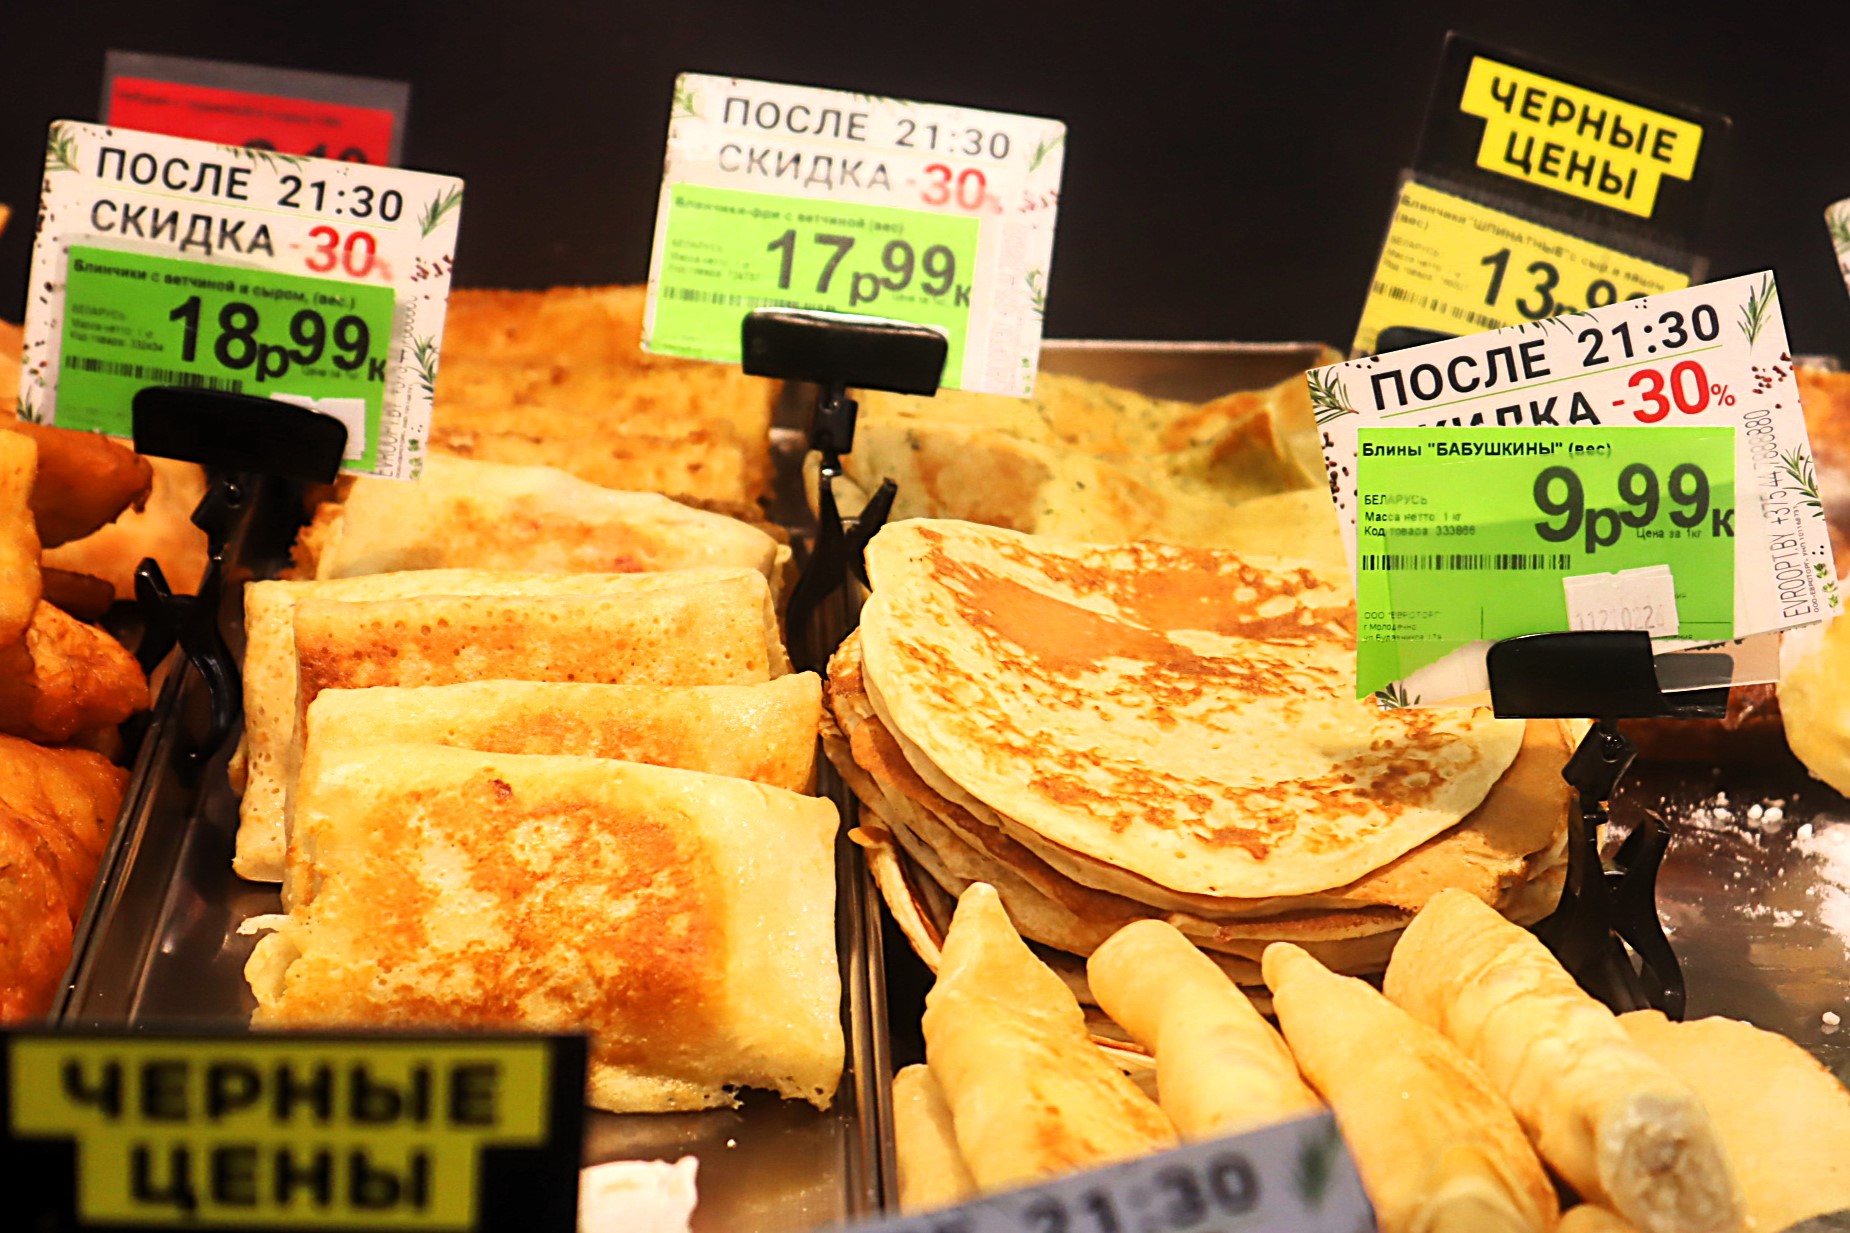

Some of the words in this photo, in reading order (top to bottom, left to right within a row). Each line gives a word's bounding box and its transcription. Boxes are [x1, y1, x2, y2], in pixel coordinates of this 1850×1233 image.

[723, 97, 870, 142] ПОСЛЕ
[895, 118, 1011, 160] 21:30
[1490, 76, 1679, 164] ЧЕРНЫЕ
[96, 146, 253, 202] ПОСЛЕ
[276, 173, 403, 222] 21:30
[718, 144, 891, 191] СКИДКА
[1503, 130, 1638, 200] ЦЕНЫ
[90, 199, 275, 257] СКИДКА
[73, 258, 146, 280] Блинчики
[164, 273, 235, 293] ветчиной
[1370, 338, 1551, 411] ПОСЛЕ
[1577, 303, 1720, 367] 21:30
[1611, 360, 1736, 424] -30%
[1362, 443, 1422, 457] Блины
[1428, 442, 1563, 456] "БАБУШКИНЫ"
[1568, 441, 1612, 459] (вес)
[1364, 494, 1428, 505] БЕЛАРУСЬ
[1365, 511, 1400, 522] Масса
[1364, 526, 1386, 537] Код
[1636, 528, 1664, 540] Цена
[1668, 530, 1681, 539] за
[1770, 534, 1811, 618] EVROOPT.BY
[62, 1056, 501, 1127] ЧЕРНЫЕ
[132, 1140, 429, 1219] ЦЕНЫ
